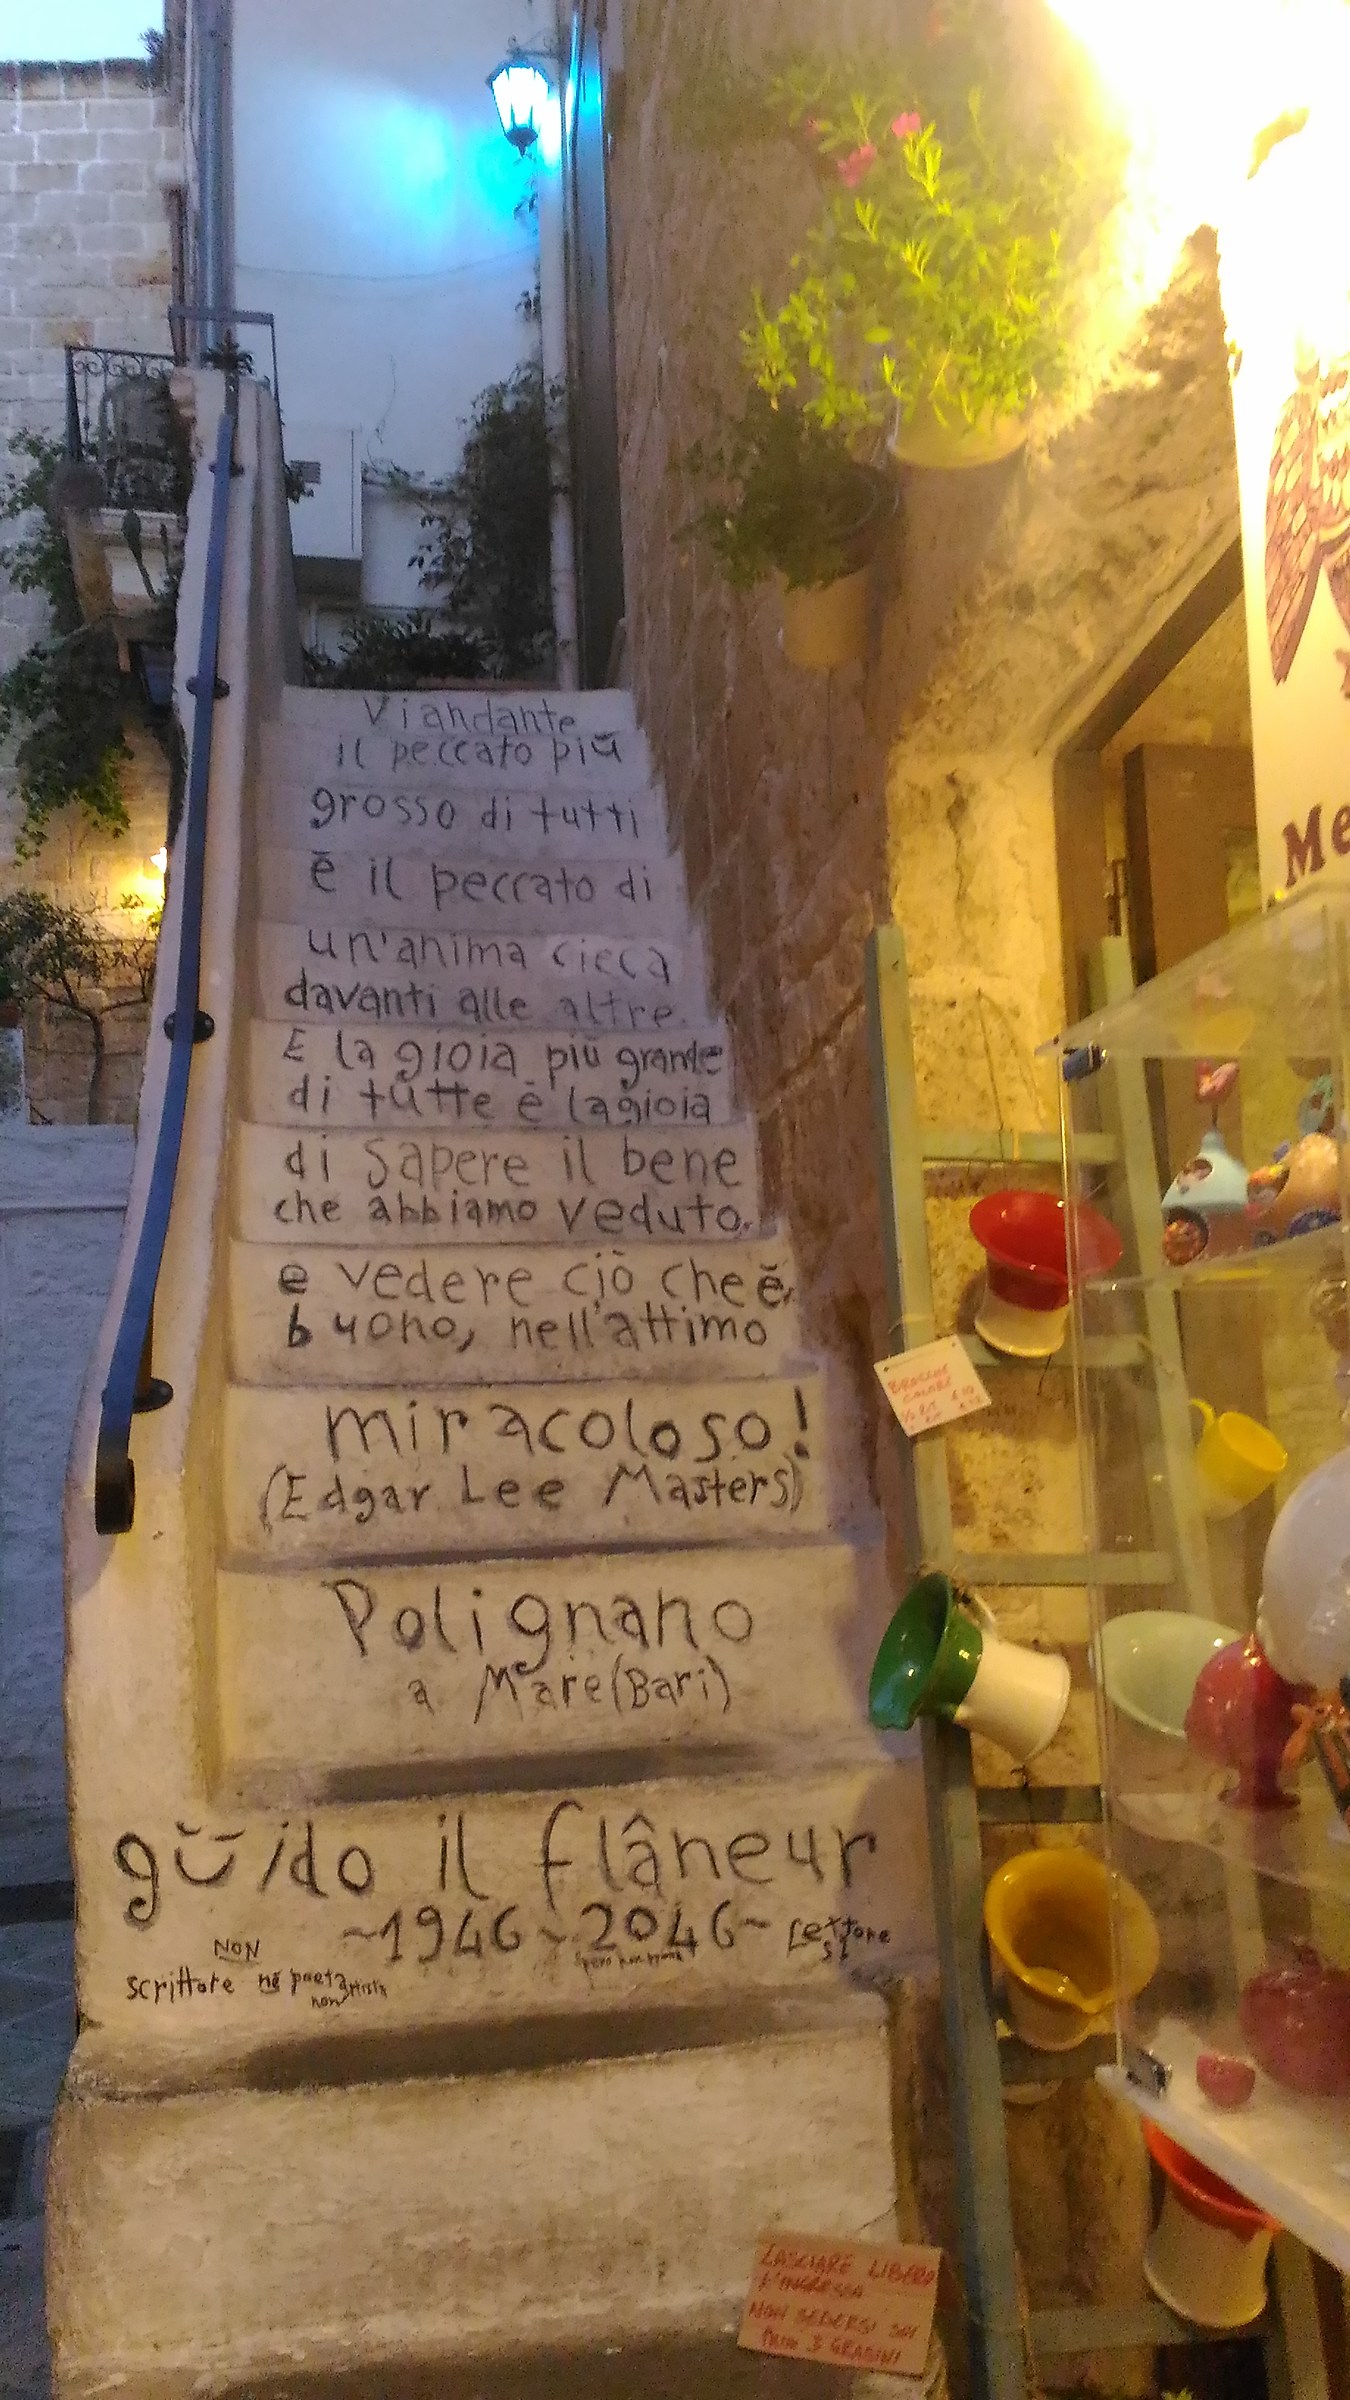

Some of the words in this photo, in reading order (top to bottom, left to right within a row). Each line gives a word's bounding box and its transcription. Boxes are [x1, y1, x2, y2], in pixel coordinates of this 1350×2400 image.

[363, 696, 577, 737] Viandante
[336, 738, 364, 770] il
[393, 736, 533, 773] peccato
[310, 787, 455, 830] grosso
[481, 797, 512, 832] di
[530, 797, 640, 838] tutti
[370, 856, 403, 900] il
[432, 862, 595, 910] peccato
[616, 866, 652, 902] di
[308, 928, 527, 968] un'anima
[552, 939, 671, 985] cieca
[284, 966, 437, 1016] davanti
[459, 985, 527, 1025] alle
[283, 1028, 306, 1062] E
[395, 1030, 518, 1083] gioia
[616, 1039, 724, 1091] grande
[288, 1075, 331, 1114] di
[359, 1080, 495, 1118] tutte
[285, 1134, 330, 1184] di
[563, 1136, 594, 1185] il
[622, 1132, 744, 1187] bene
[273, 1188, 342, 1224] che
[369, 1189, 538, 1228] abbiamo
[277, 1262, 310, 1296] e
[338, 1259, 534, 1305] vedere
[462, 1463, 566, 1510] Lee
[321, 1578, 754, 1676] Polignano
[408, 1678, 436, 1714] a
[439, 1811, 489, 1901] il
[213, 1937, 261, 1963] NON
